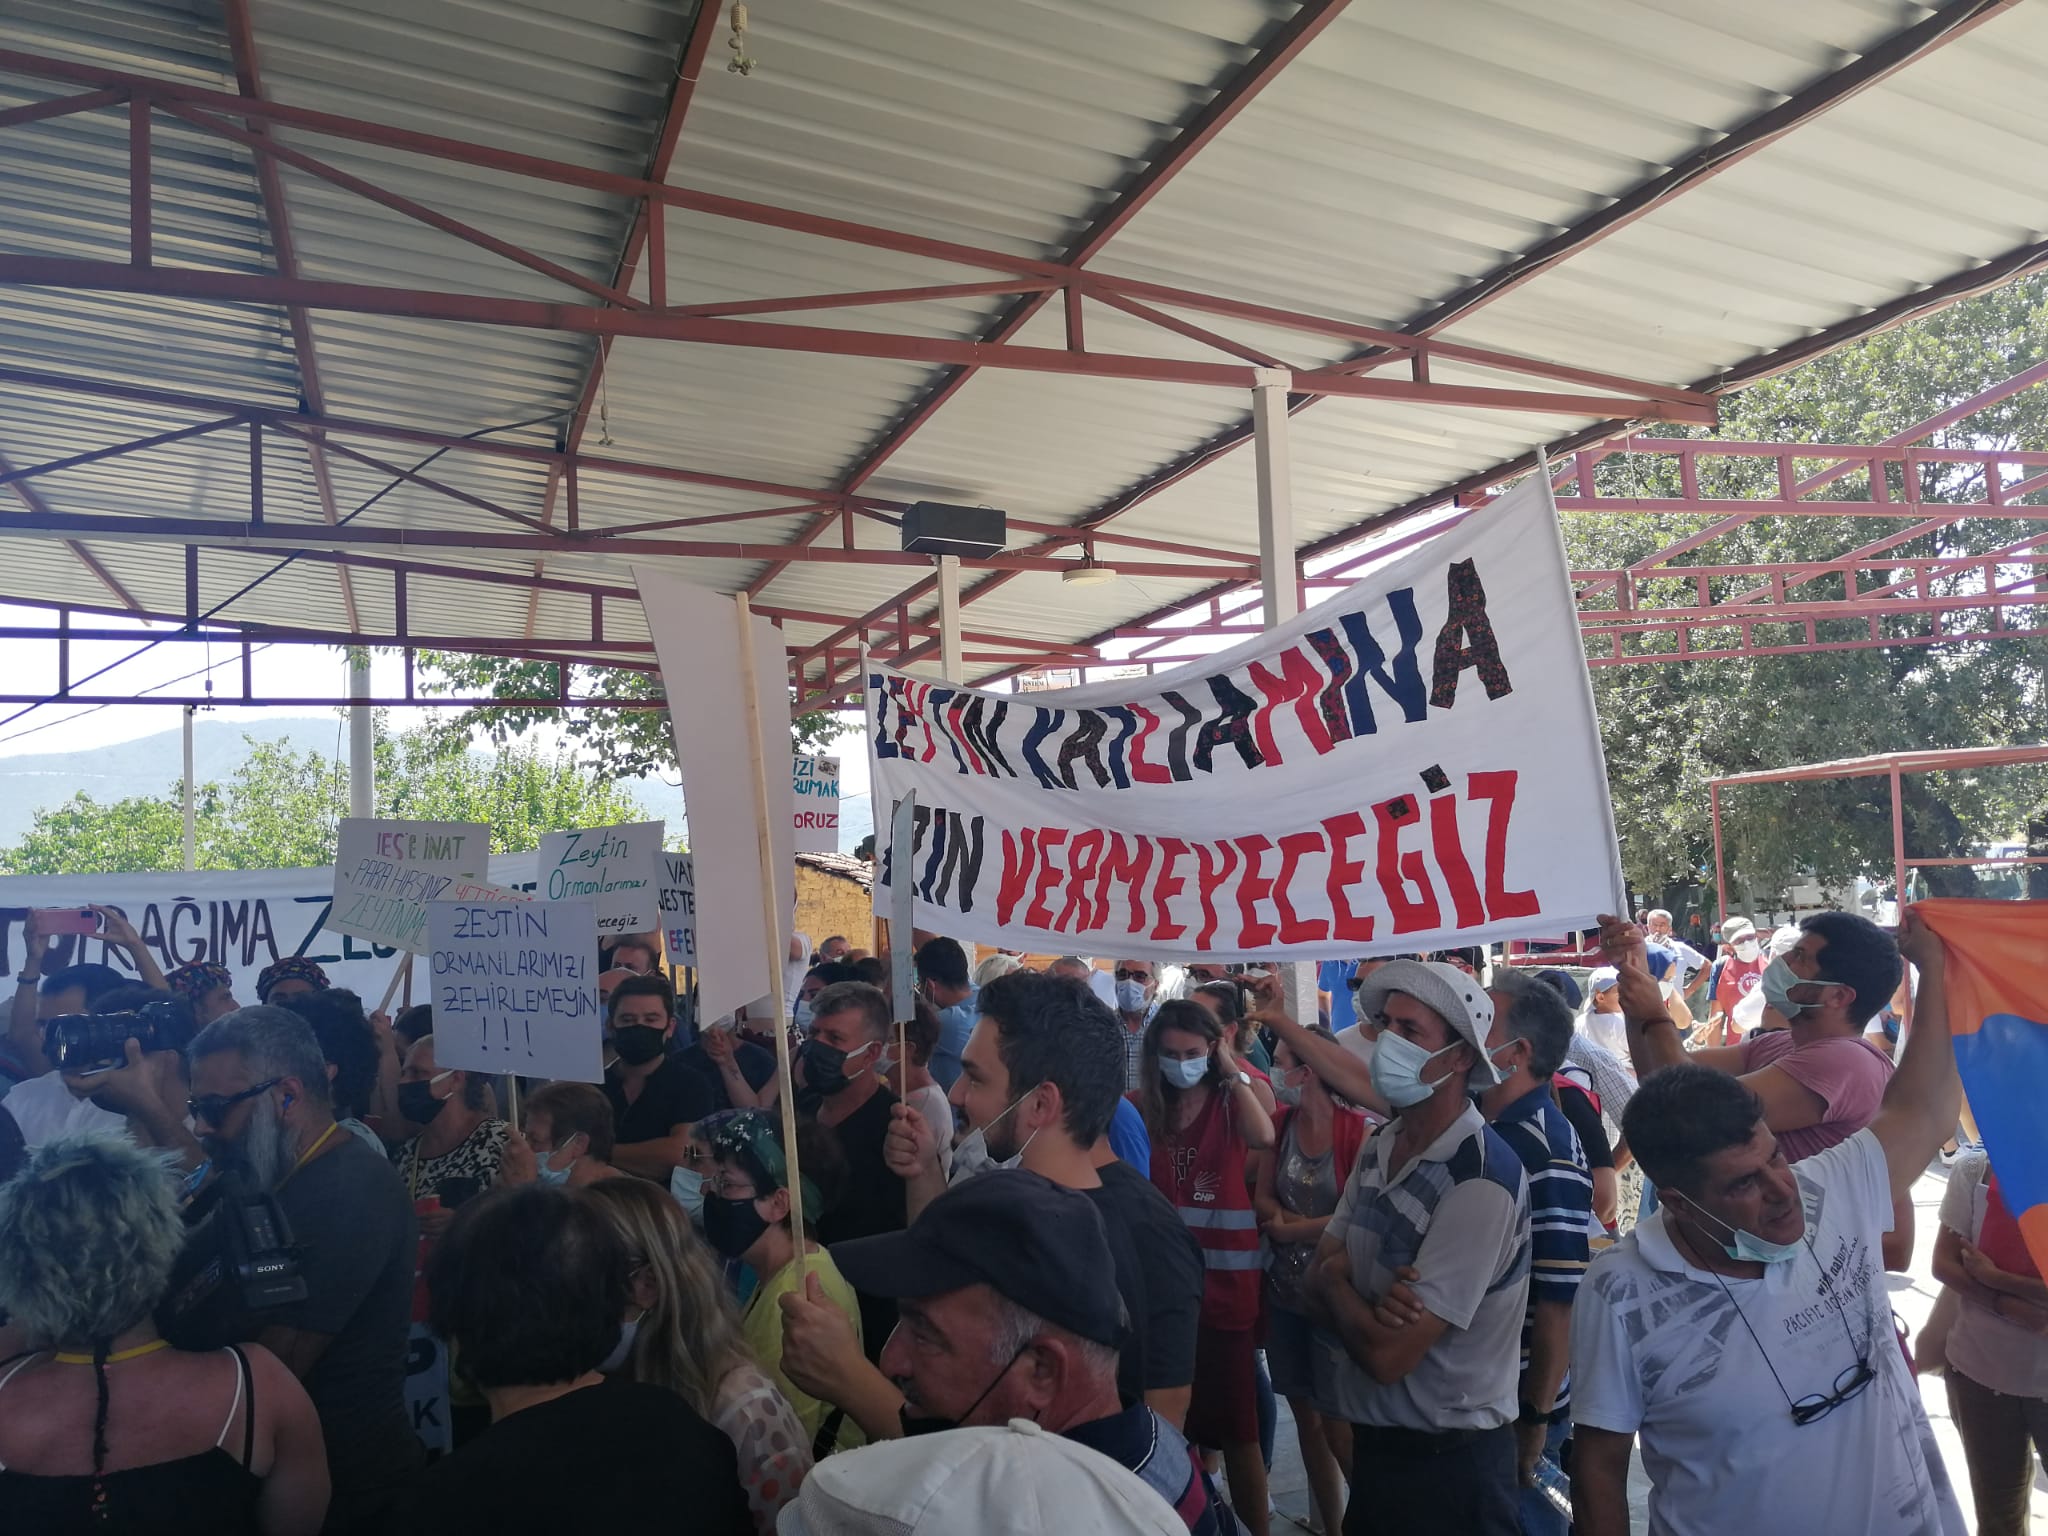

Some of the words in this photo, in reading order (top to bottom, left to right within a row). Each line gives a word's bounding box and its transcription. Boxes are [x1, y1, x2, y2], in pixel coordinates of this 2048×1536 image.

[559, 831, 629, 868] Zeytin
[668, 928, 697, 955] EFE
[432, 950, 586, 980] ORMANLARIMIZI
[442, 981, 598, 1018] ZEHİRLEMEYİN
[1193, 1191, 1216, 1203] CHP
[256, 1263, 285, 1273] SONY
